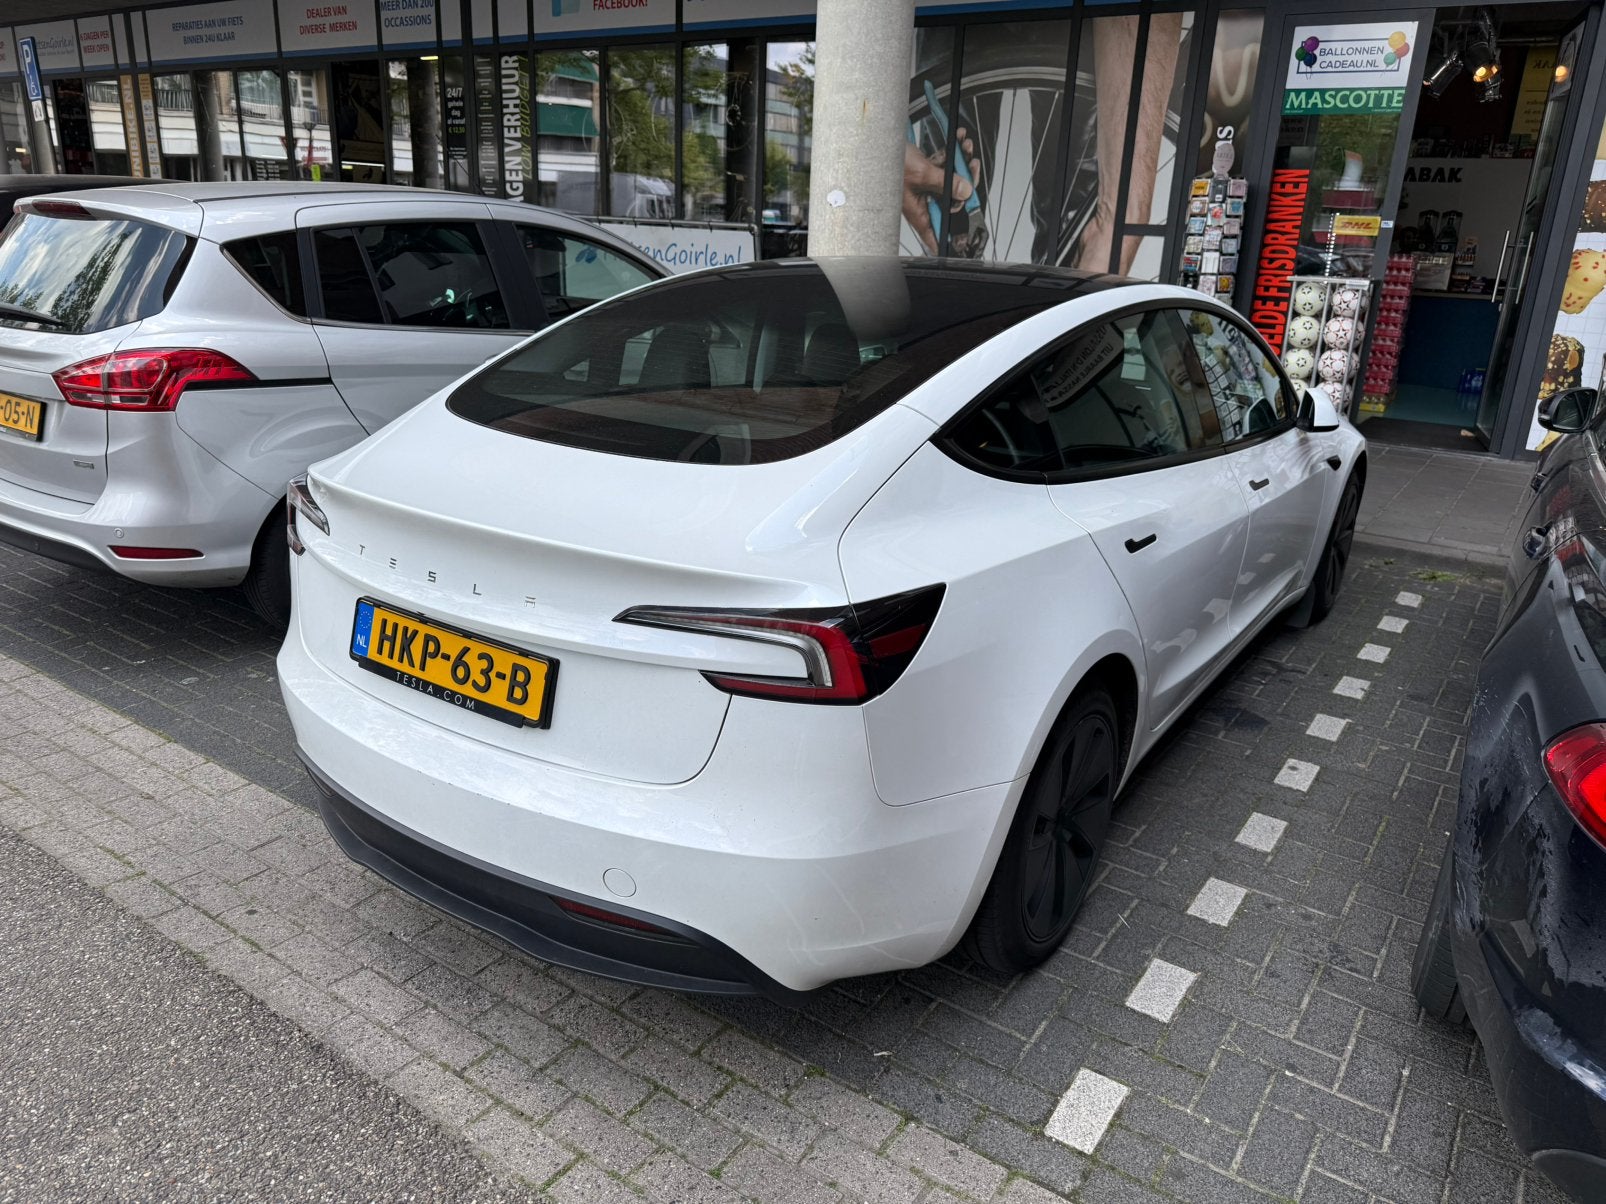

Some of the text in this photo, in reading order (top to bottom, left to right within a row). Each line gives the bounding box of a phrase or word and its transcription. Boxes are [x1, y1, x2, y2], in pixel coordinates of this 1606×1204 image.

[306, 5, 348, 19] DEALER VAN
[381, 0, 400, 11] MEER
[402, 0, 418, 10] DAN
[172, 16, 244, 32] REPARATIES AAN UW FIETS
[299, 20, 358, 36] DIVERSE MERKEN
[384, 14, 432, 28] OCCASSIONS
[183, 34, 204, 45] BINNEN
[216, 31, 236, 42] KLAAR
[1319, 46, 1385, 57] BALLONNEN
[1319, 59, 1379, 70] CADEAU.NL
[446, 87, 463, 99] 24/7
[1285, 89, 1406, 110] MASCOTTE
[501, 55, 522, 153] VERHUUR
[518, 69, 531, 138] BUDGET
[520, 142, 533, 180] LOW
[1403, 166, 1463, 183] ABAK
[1255, 168, 1311, 298] FRISDRANKEN
[1342, 221, 1373, 230] DHL
[0, 399, 35, 429] -05-N
[359, 544, 536, 609] TESLA
[356, 633, 367, 649] NL
[376, 617, 532, 706] HKP-63-B
[396, 671, 475, 710] TESLA.COM
